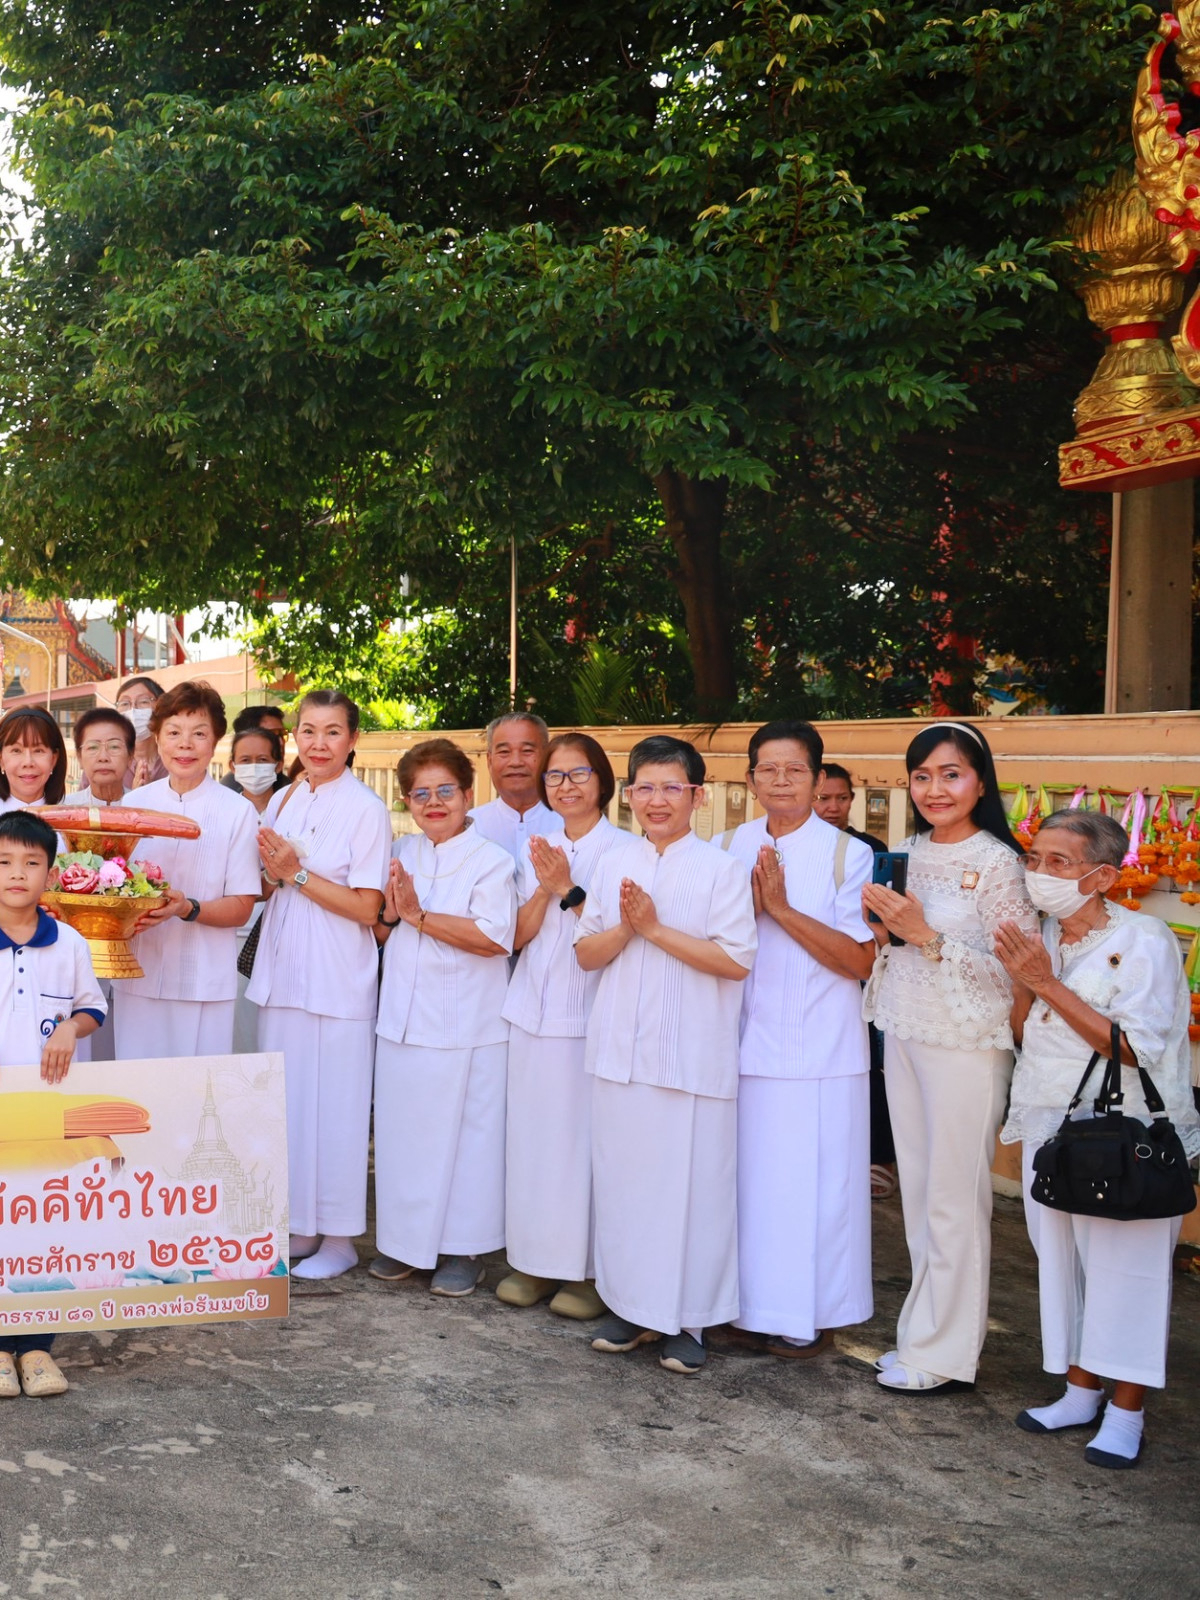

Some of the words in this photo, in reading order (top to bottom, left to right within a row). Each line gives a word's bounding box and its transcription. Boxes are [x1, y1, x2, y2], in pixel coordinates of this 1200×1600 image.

[148, 1232, 274, 1268] ๒๕๖๘
[67, 1308, 94, 1321] ๘๑
[101, 1300, 114, 1319] ปี
[121, 1291, 268, 1318] หลวงพ่อธัมมชโย
